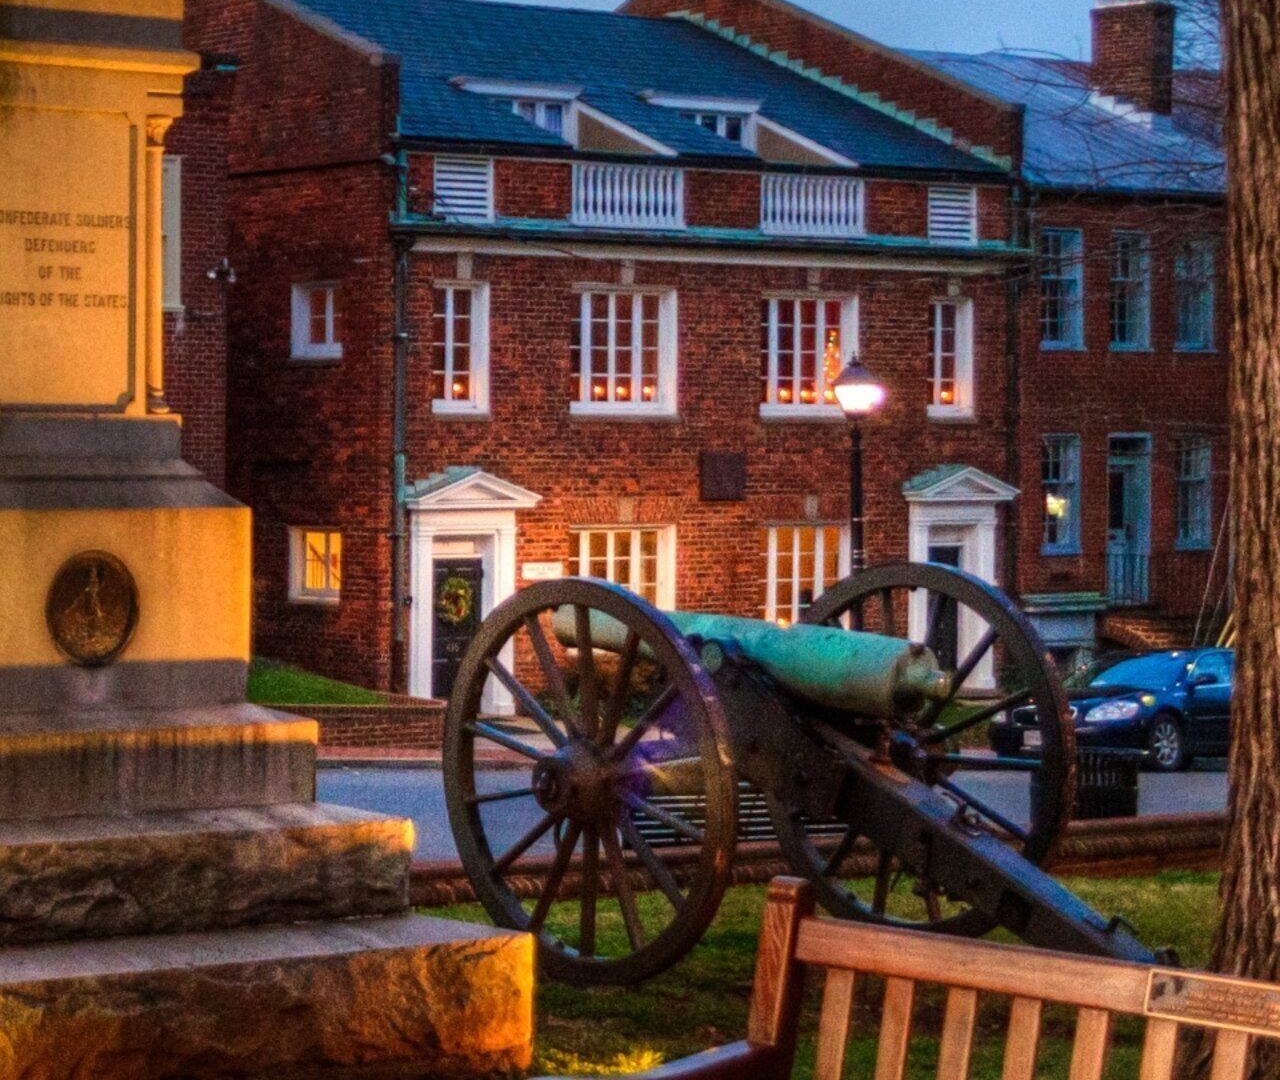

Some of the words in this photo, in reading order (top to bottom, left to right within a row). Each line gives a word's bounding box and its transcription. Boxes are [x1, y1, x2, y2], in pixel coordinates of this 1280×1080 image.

[76, 214, 130, 229] SOLDIERS
[25, 238, 96, 253] DEFENDERS
[38, 265, 53, 280] OF
[59, 265, 81, 280] THE
[39, 292, 54, 307] OF
[58, 292, 80, 307] THE
